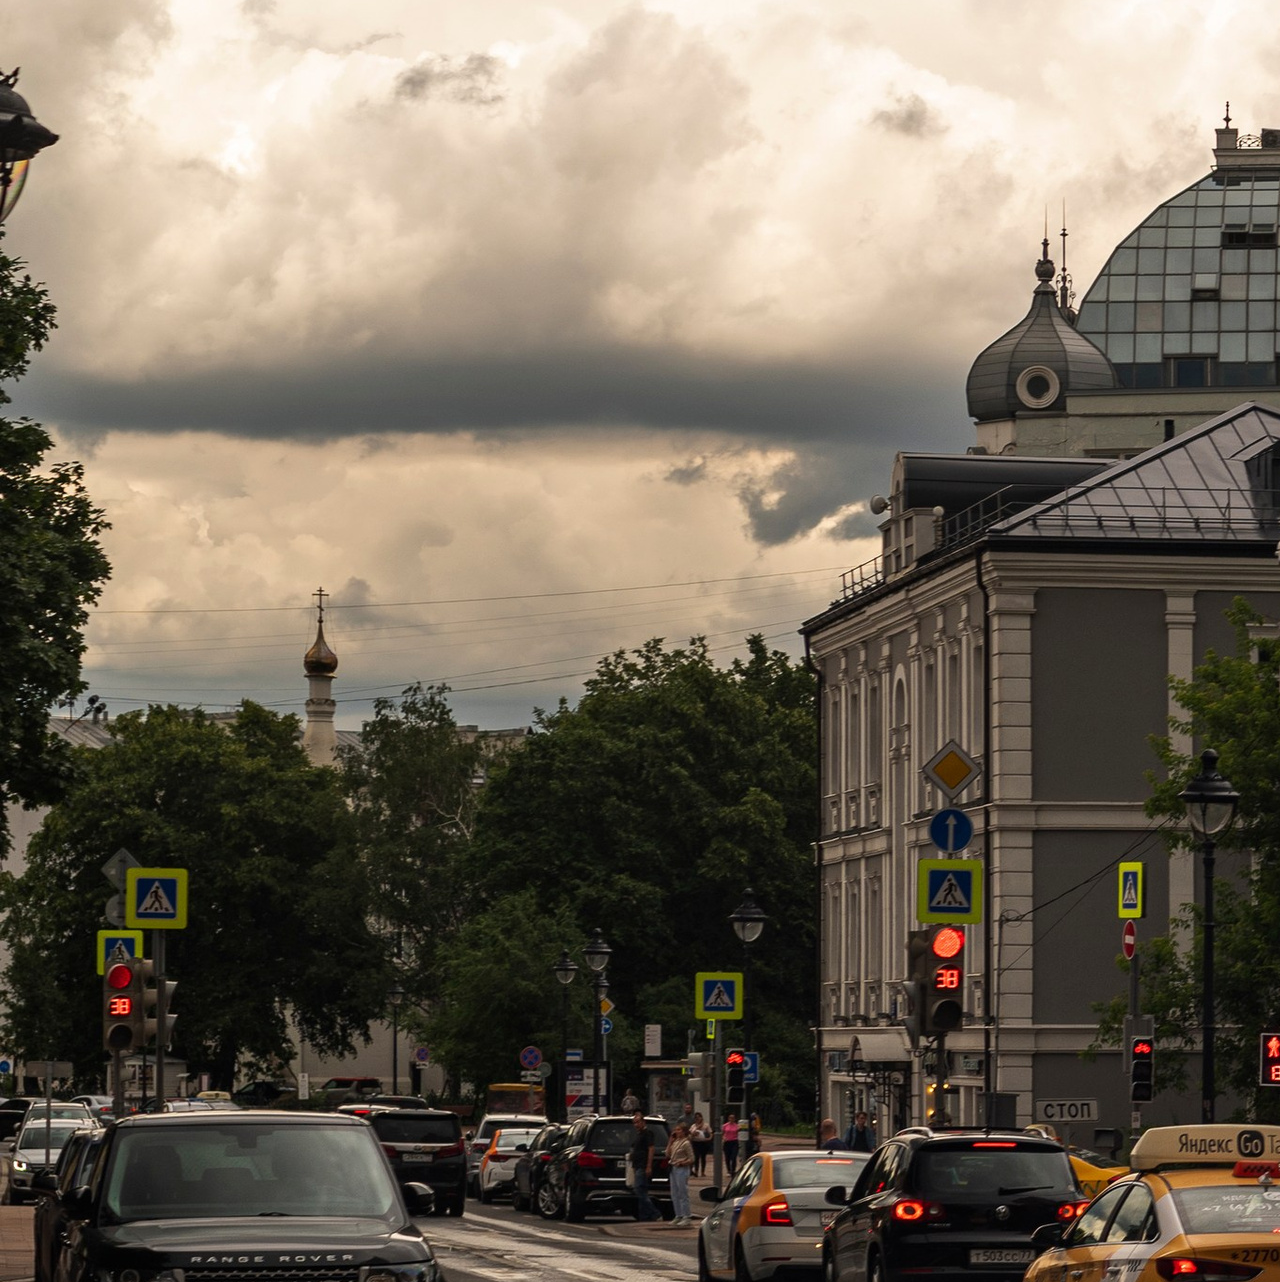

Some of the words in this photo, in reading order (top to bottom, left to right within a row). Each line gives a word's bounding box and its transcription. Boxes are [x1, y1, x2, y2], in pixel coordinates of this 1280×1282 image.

[936, 970, 959, 988] 38
[109, 998, 131, 1015] 38
[1044, 1103, 1091, 1118] СТОП
[1178, 1133, 1233, 1155] Яндекс
[1239, 1135, 1262, 1154] Go
[190, 1255, 265, 1263] RANGE
[278, 1254, 354, 1262] ROVER
